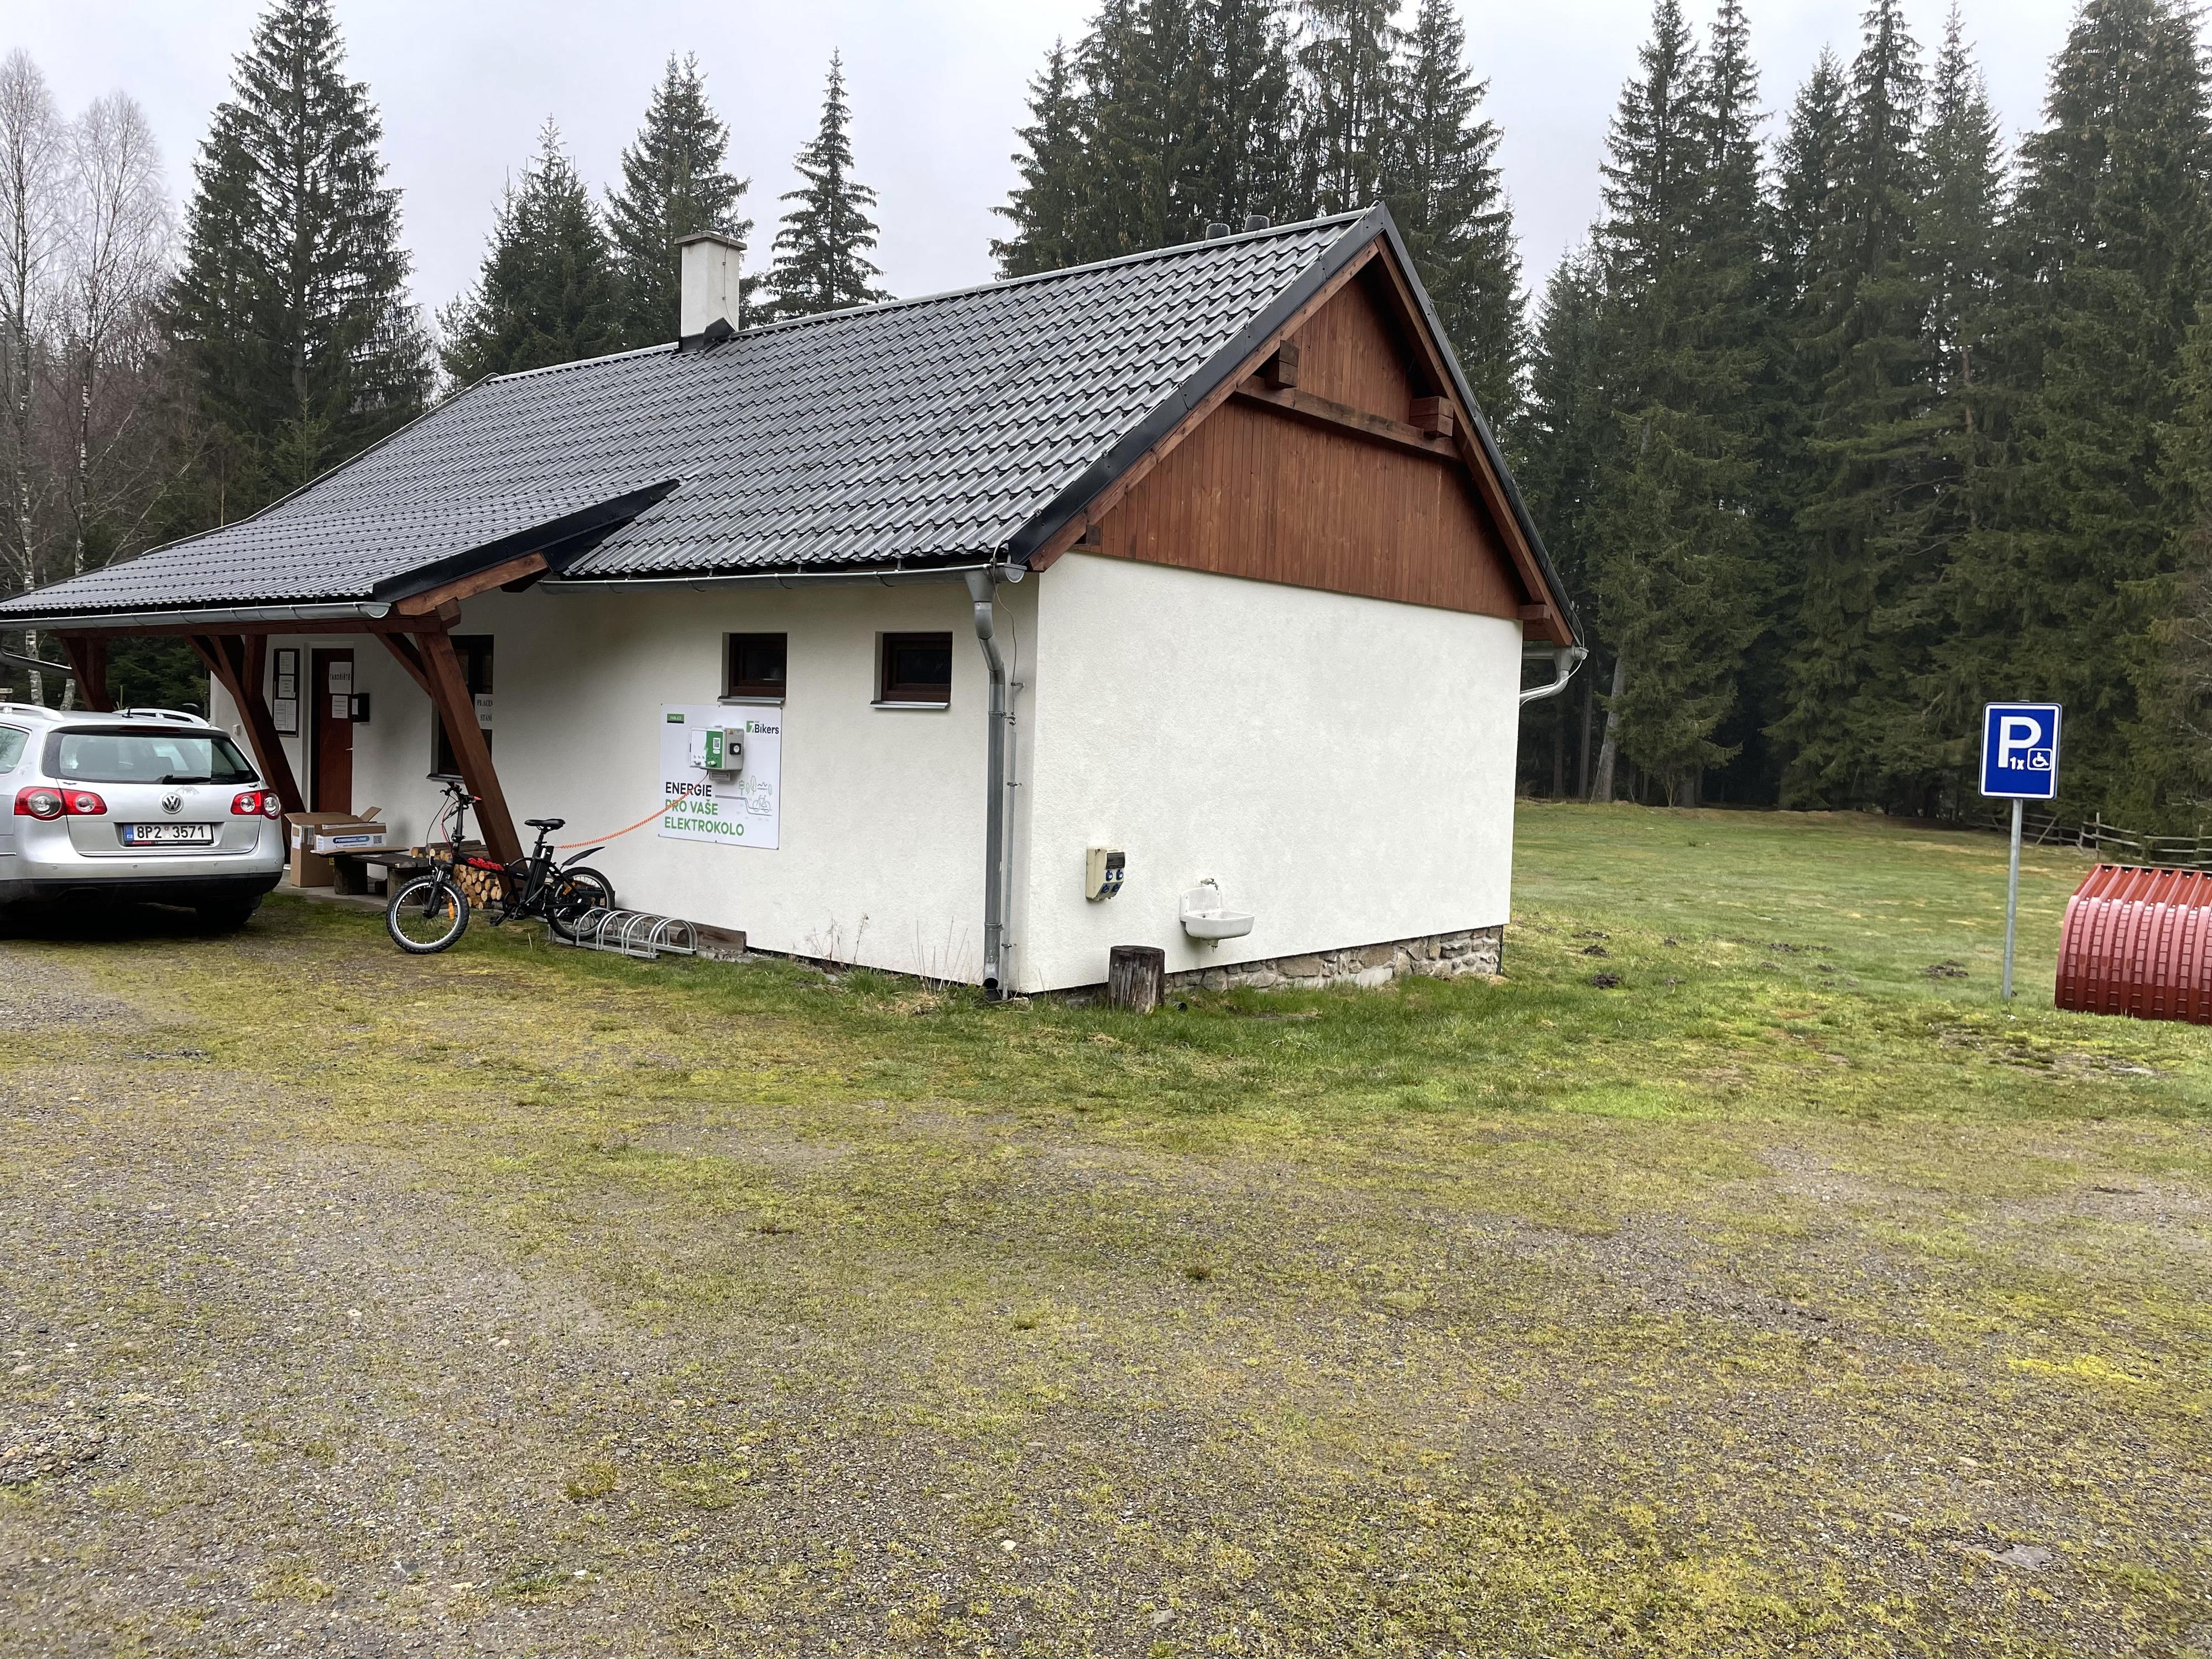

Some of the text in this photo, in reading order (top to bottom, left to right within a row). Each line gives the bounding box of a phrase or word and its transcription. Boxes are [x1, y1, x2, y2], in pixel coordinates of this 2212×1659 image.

[755, 724, 779, 734] Bikers
[1998, 716, 2042, 768] P
[2010, 757, 2025, 770] 1x
[665, 781, 712, 797] ENERGIE
[665, 799, 718, 816] PRO VAŠE
[137, 826, 204, 838] 8P2 3571
[665, 816, 744, 836] ELEKTROKOLO
